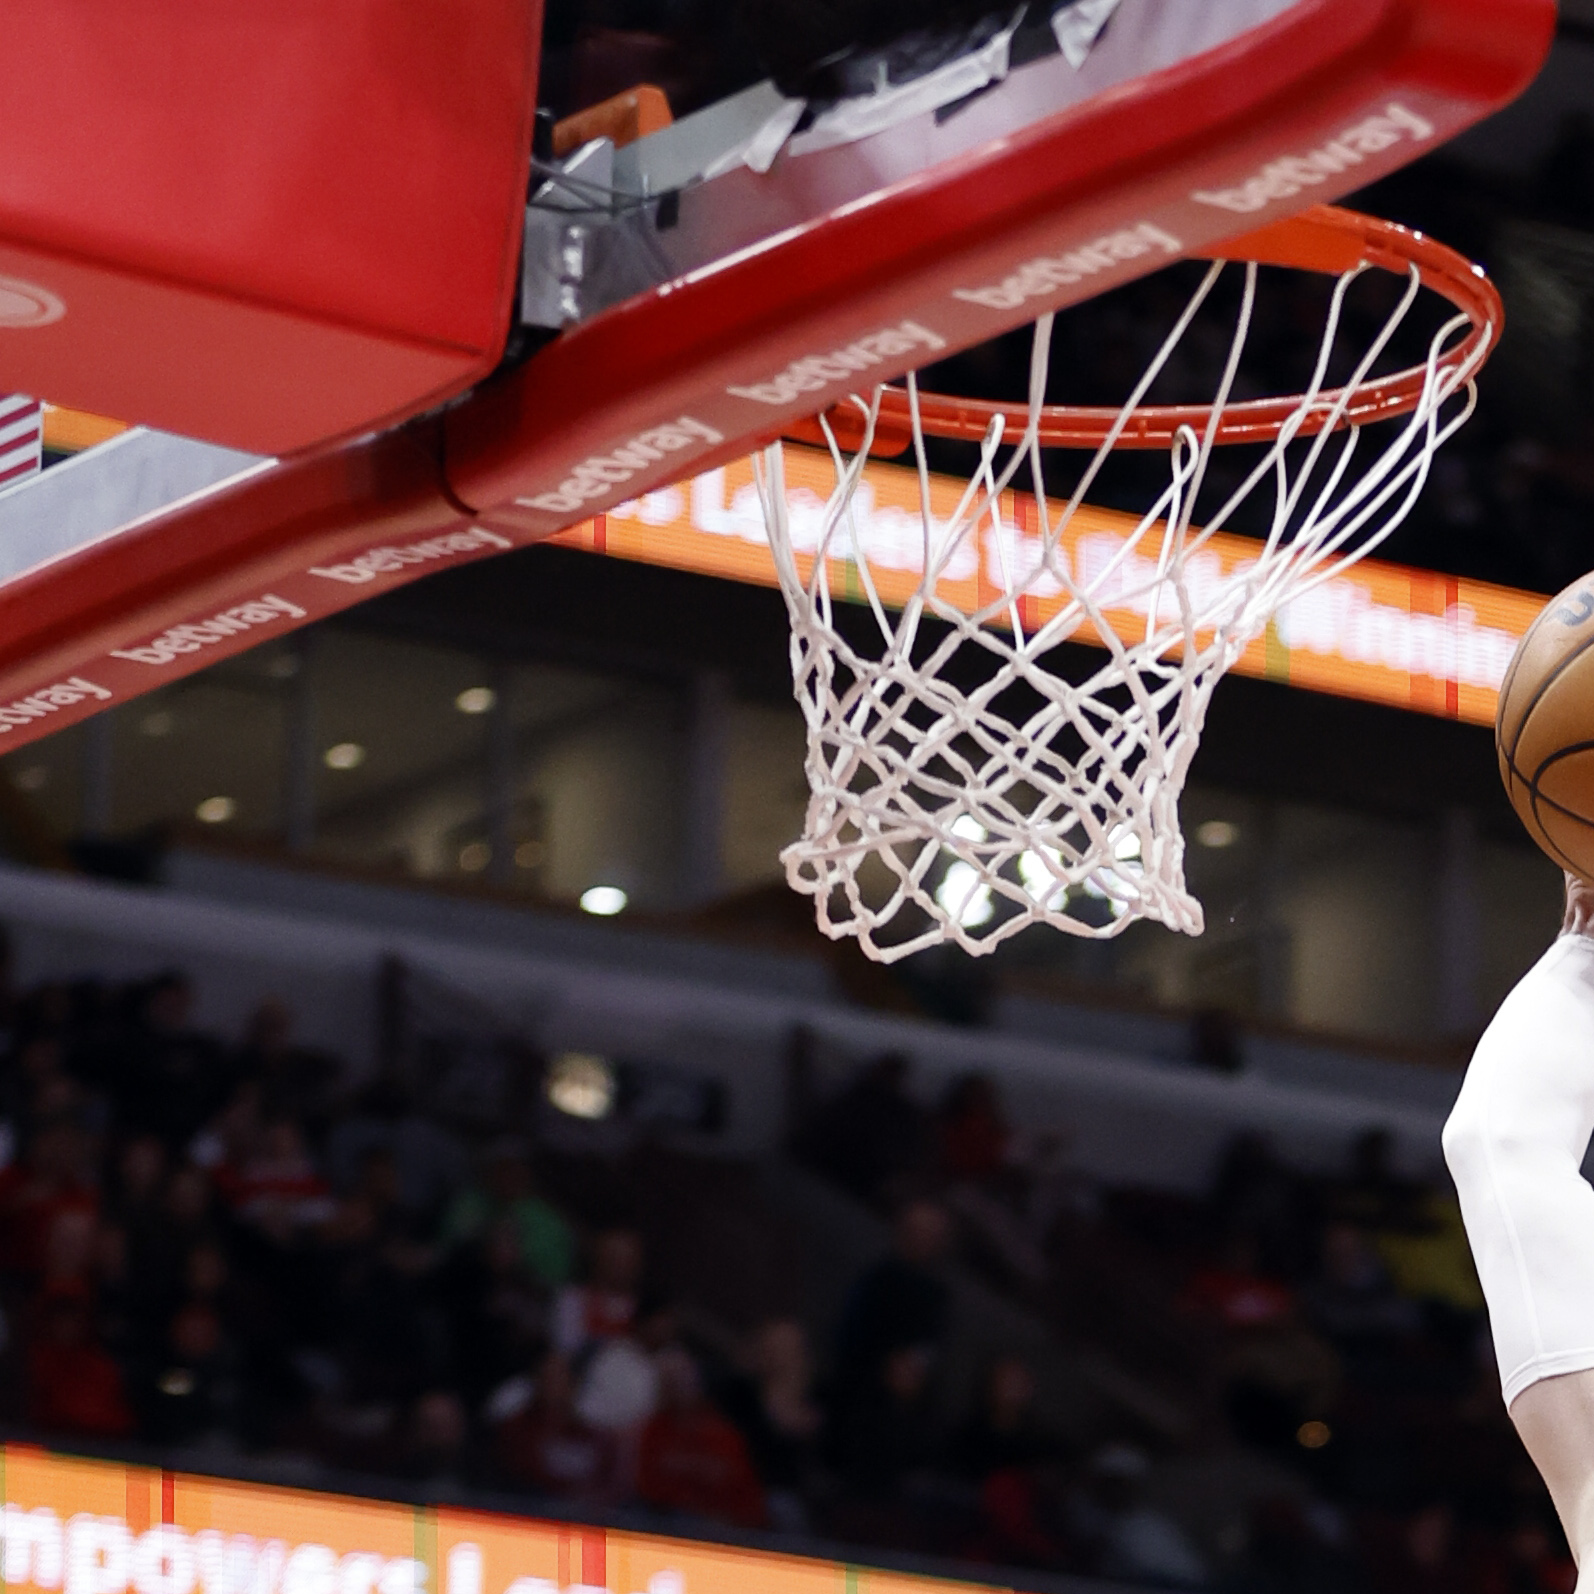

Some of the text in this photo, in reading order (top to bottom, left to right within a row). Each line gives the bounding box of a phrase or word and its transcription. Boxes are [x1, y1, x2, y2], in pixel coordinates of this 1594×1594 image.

[0, 676, 113, 734] tway
[109, 593, 307, 666] betway
[308, 525, 513, 585] betway
[515, 415, 724, 513] betway
[726, 320, 947, 405] betway
[952, 220, 1182, 310] betway
[1189, 102, 1434, 214] betway
